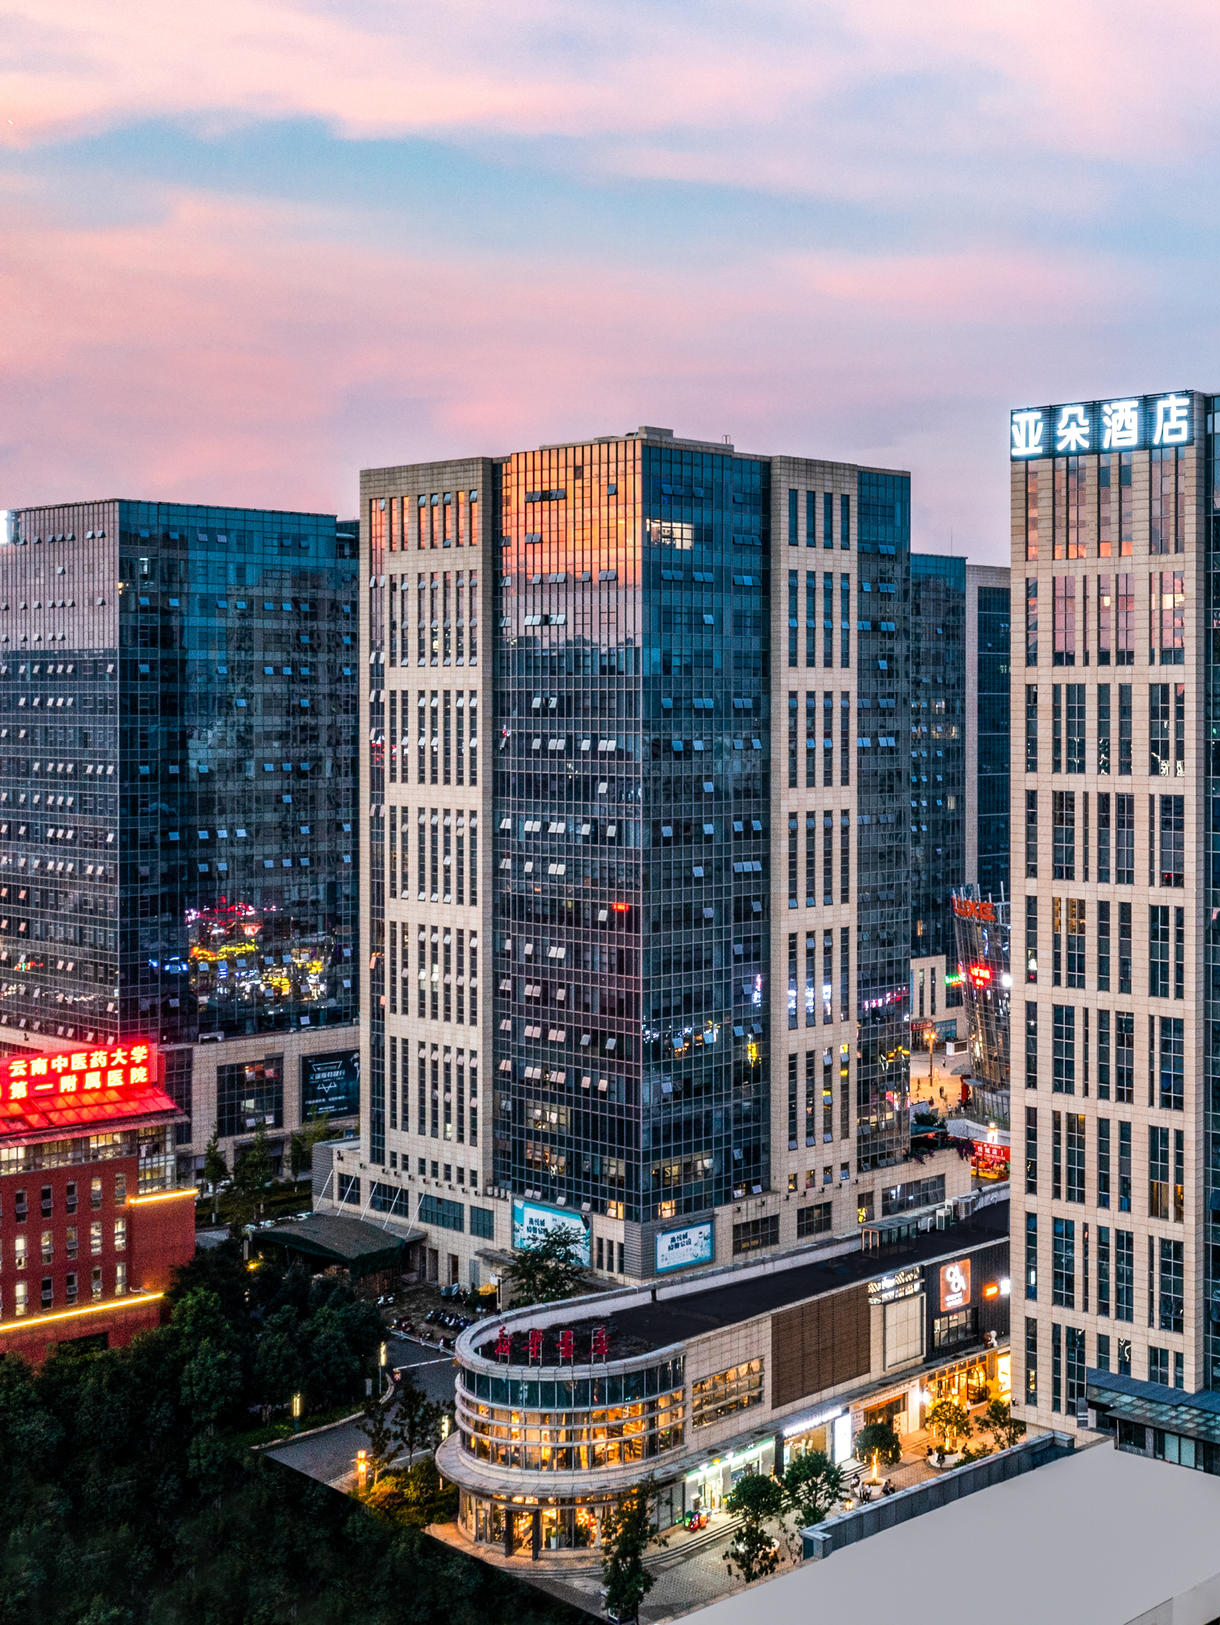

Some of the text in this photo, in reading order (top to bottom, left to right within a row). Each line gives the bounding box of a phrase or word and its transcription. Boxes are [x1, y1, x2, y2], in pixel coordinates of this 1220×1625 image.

[1011, 394, 1190, 456] 亚朵酒店
[9, 1045, 148, 1077] 云南中医药大学
[9, 1066, 148, 1099] 第一附属医院
